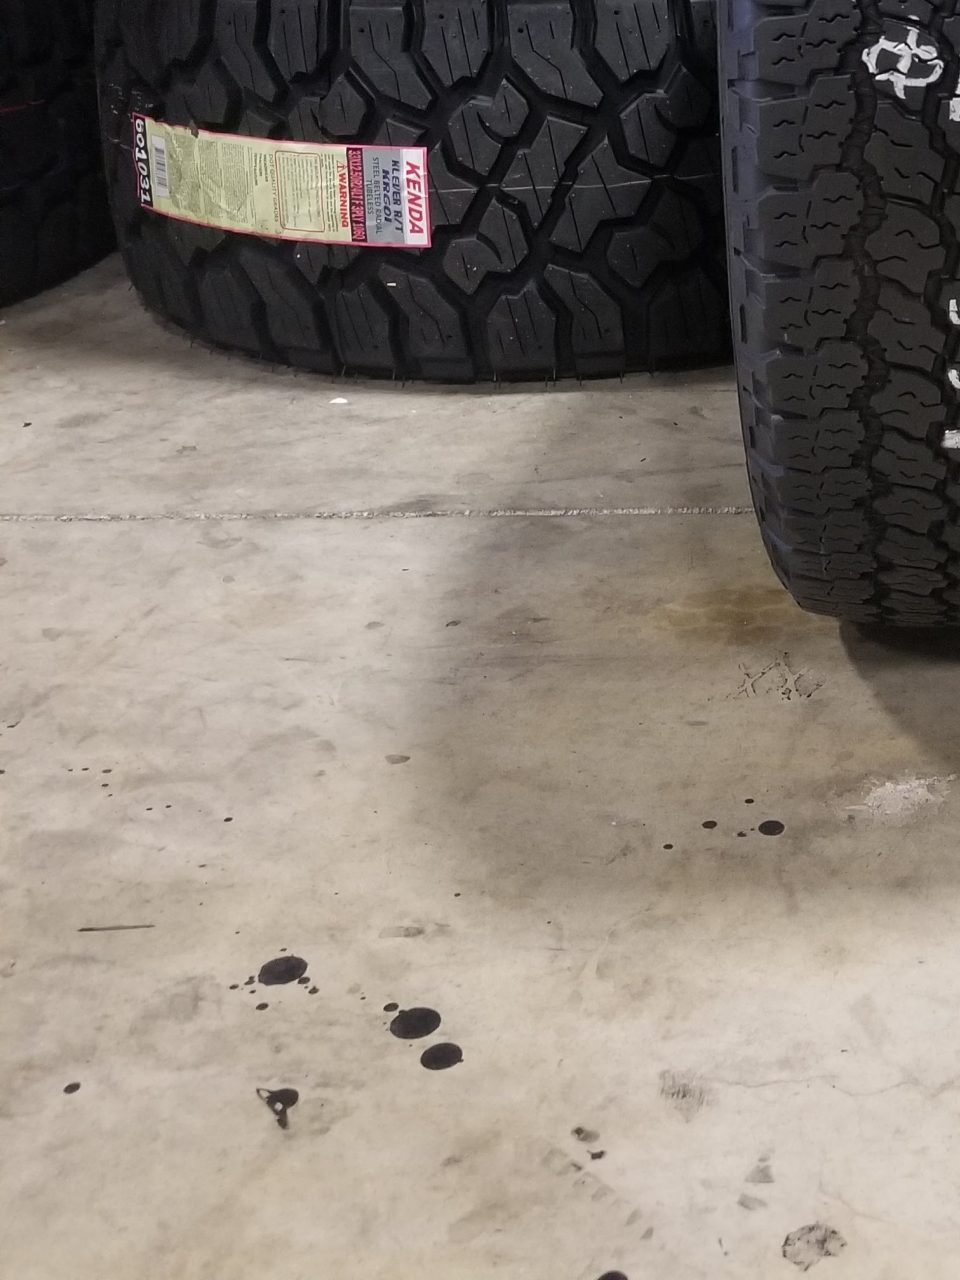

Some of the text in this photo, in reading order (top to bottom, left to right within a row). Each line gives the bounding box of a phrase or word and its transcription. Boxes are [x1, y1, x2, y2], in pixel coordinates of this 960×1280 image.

[135, 118, 151, 204] 601031
[339, 173, 349, 227] WARNING
[366, 179, 374, 215] TUBELESS
[373, 180, 381, 207] BELTED
[392, 160, 403, 233] KLEVER R/T
[406, 161, 424, 233] KENDA
